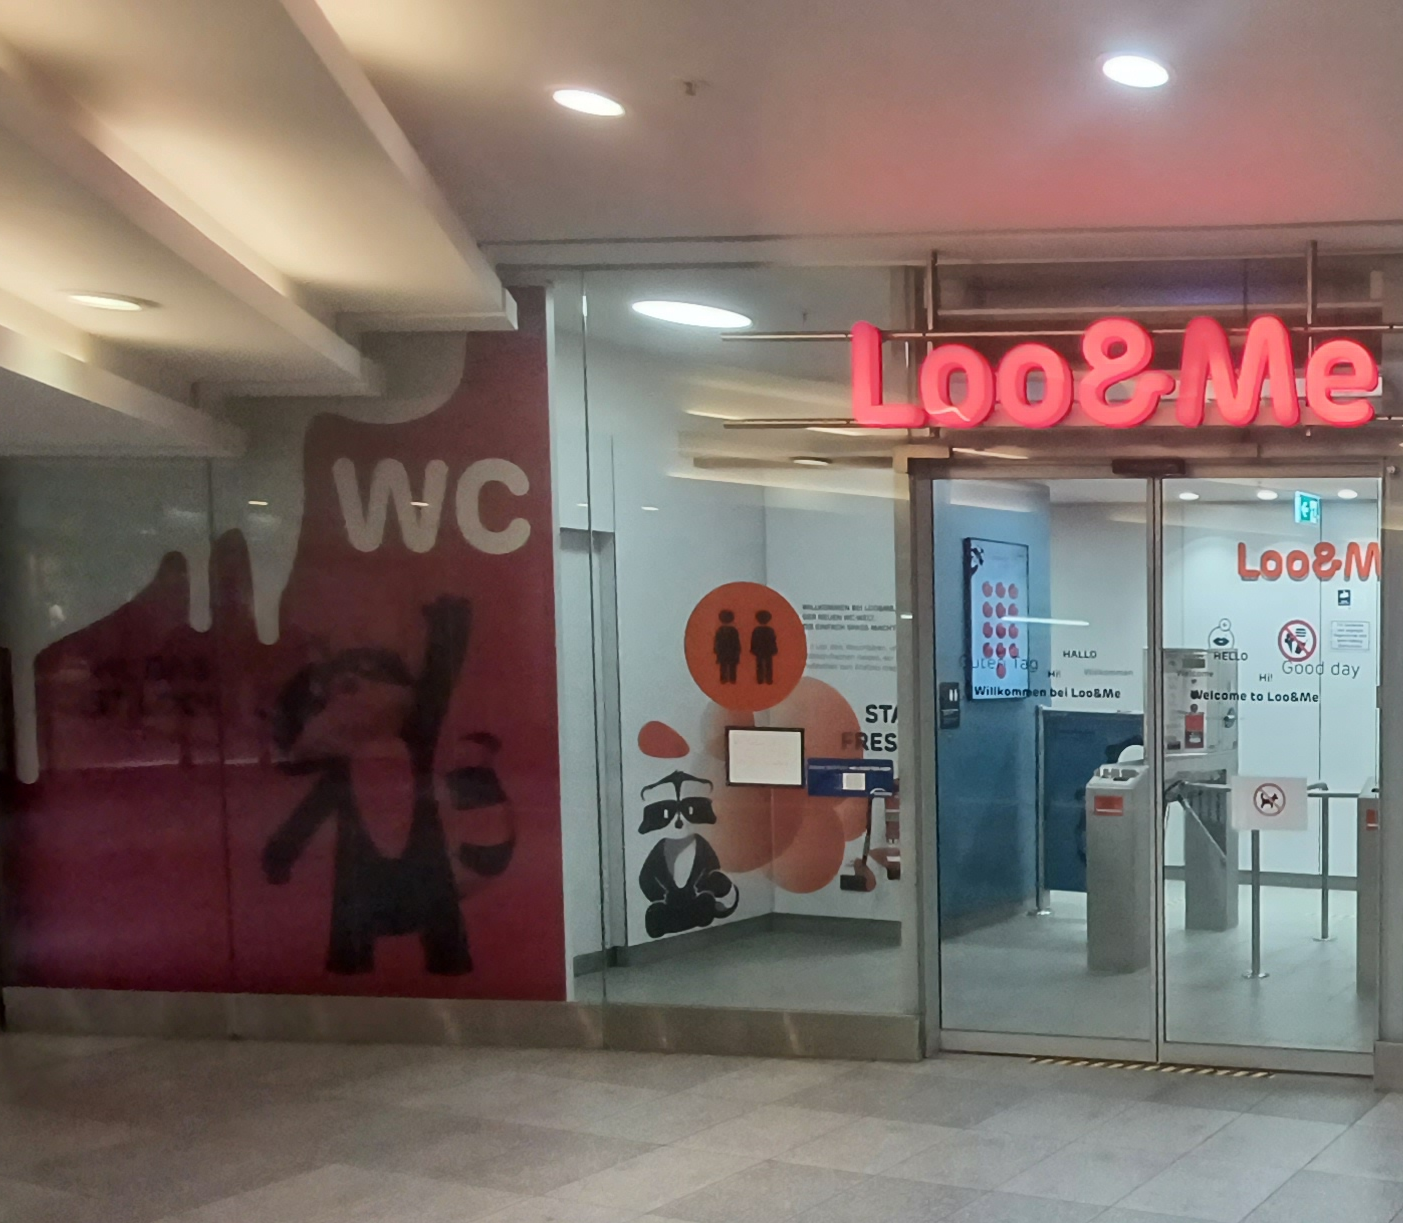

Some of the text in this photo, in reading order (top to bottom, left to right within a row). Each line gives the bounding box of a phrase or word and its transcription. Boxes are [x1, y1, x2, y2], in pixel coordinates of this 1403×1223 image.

[850, 314, 1379, 428] Loo&Me
[331, 457, 532, 555] WC
[1062, 650, 1097, 659] HALLO
[1213, 651, 1249, 661] HELLO
[1281, 660, 1361, 680] Good day
[1259, 673, 1273, 682] Hi!
[974, 686, 1121, 699] Willkommen bei Loo&Me
[1191, 689, 1319, 703] Welcome to Loo&Me
